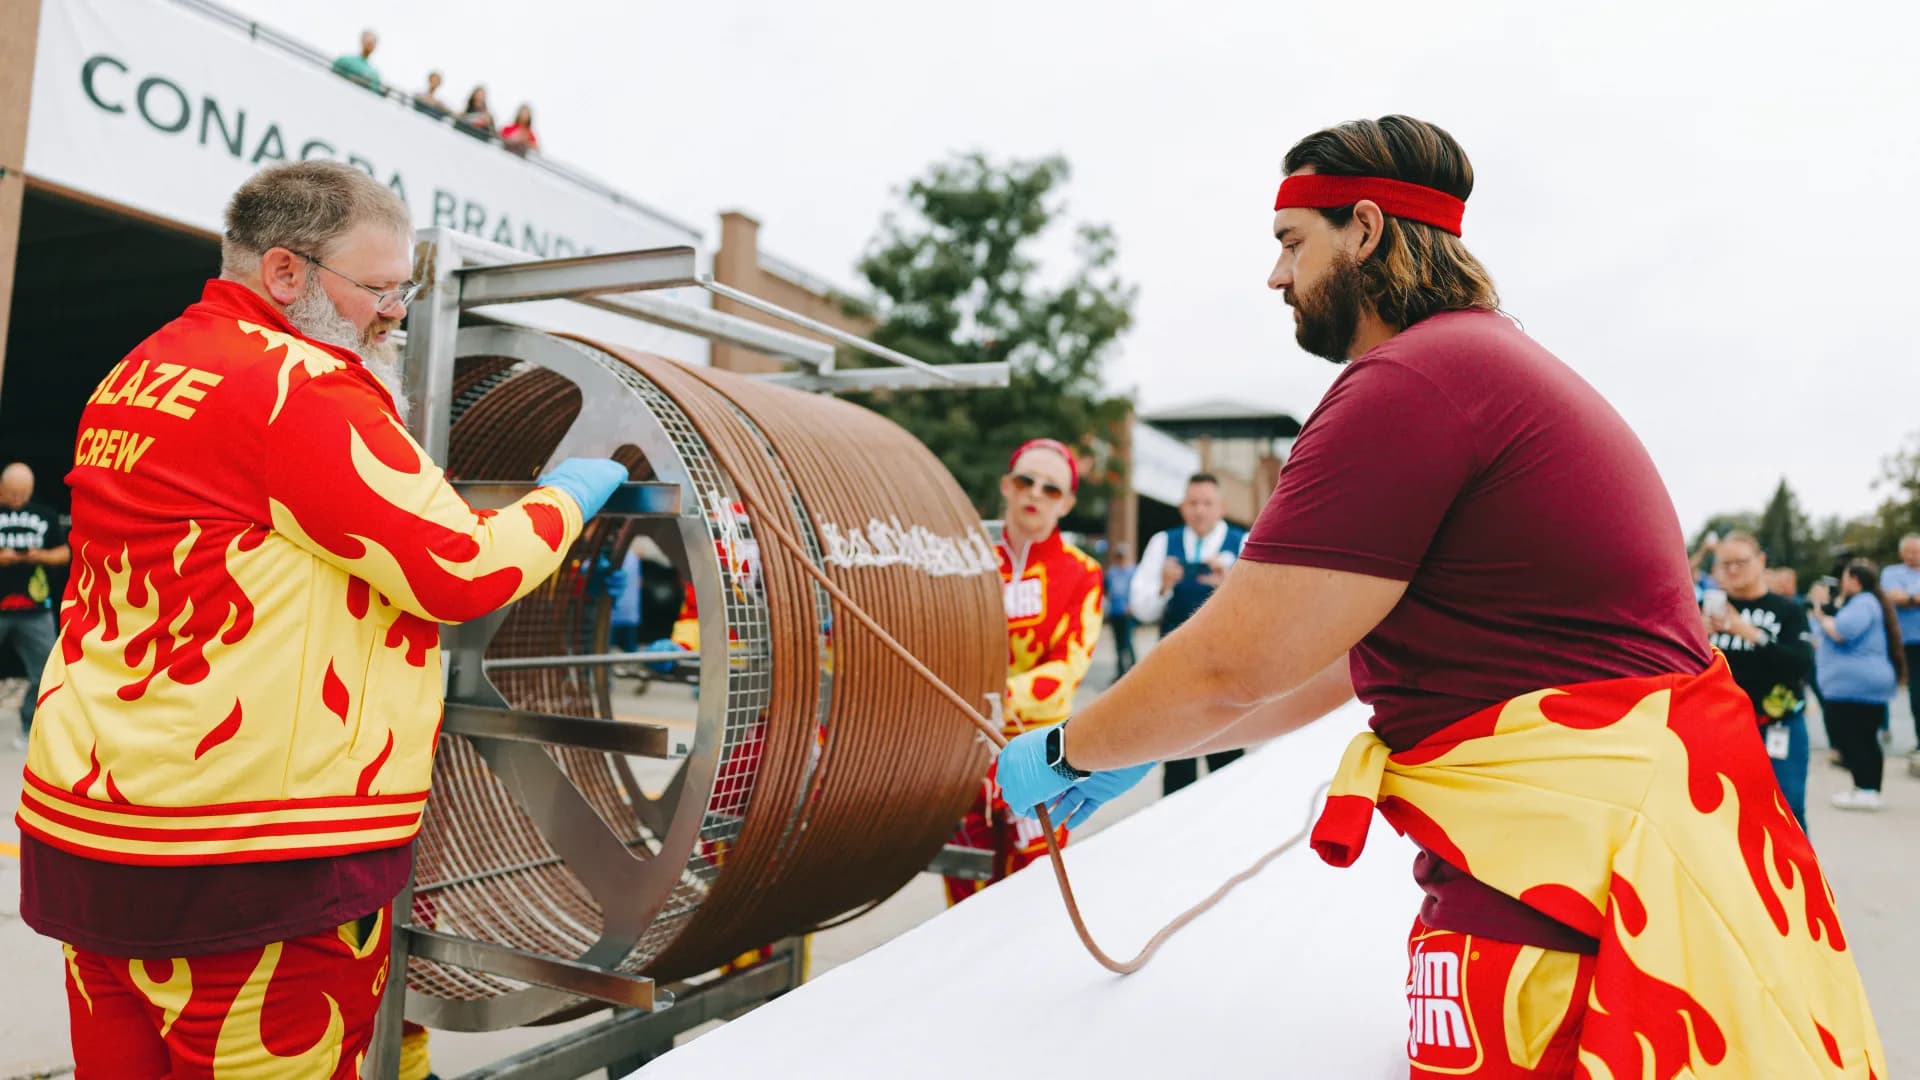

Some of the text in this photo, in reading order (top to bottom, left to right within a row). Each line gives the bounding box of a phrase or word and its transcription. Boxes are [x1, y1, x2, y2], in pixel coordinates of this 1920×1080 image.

[433, 189, 596, 257] BRAND
[86, 359, 225, 420] LAZE
[75, 427, 156, 473] CREW
